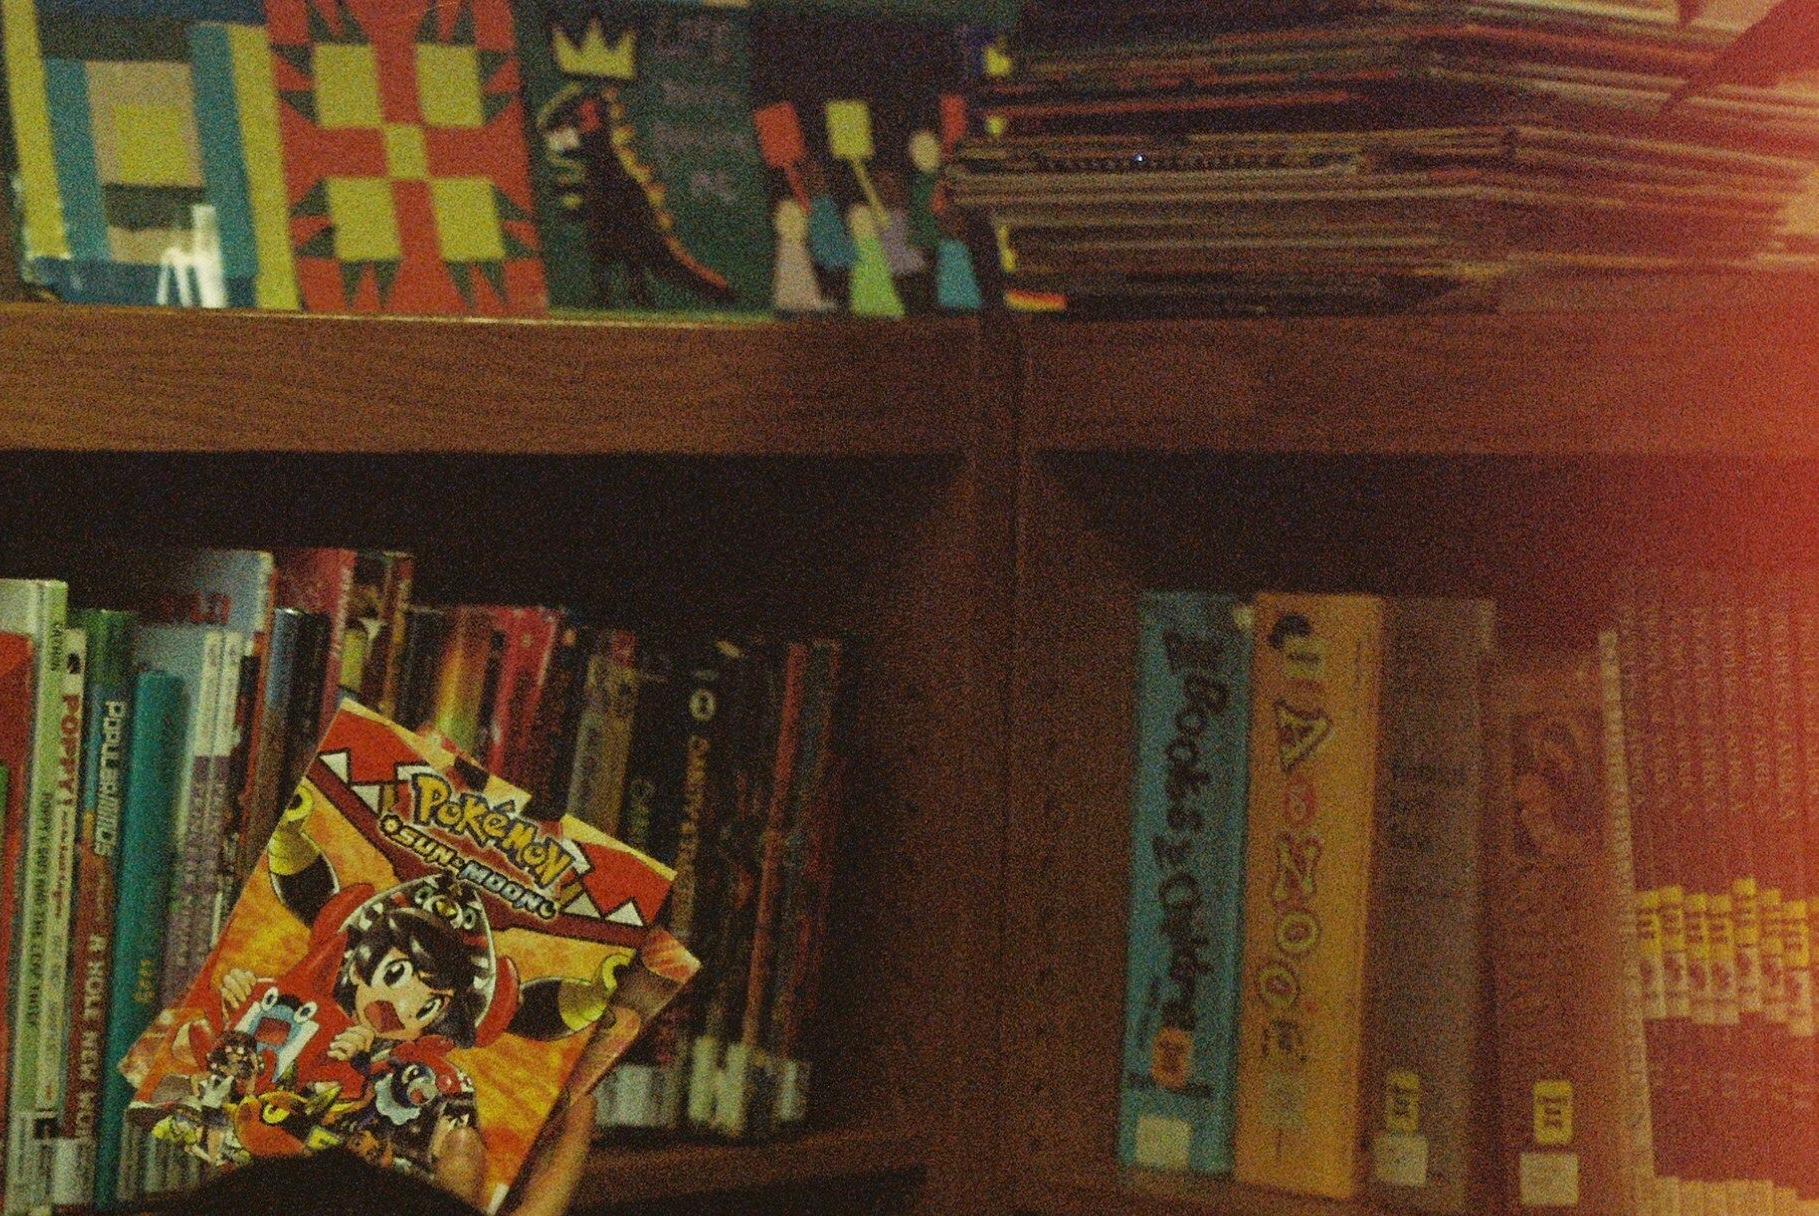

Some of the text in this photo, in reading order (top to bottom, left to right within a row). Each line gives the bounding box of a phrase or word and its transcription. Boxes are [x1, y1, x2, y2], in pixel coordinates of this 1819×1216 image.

[390, 826, 545, 912] SUN MOON
[79, 1030, 101, 1081] NEW
